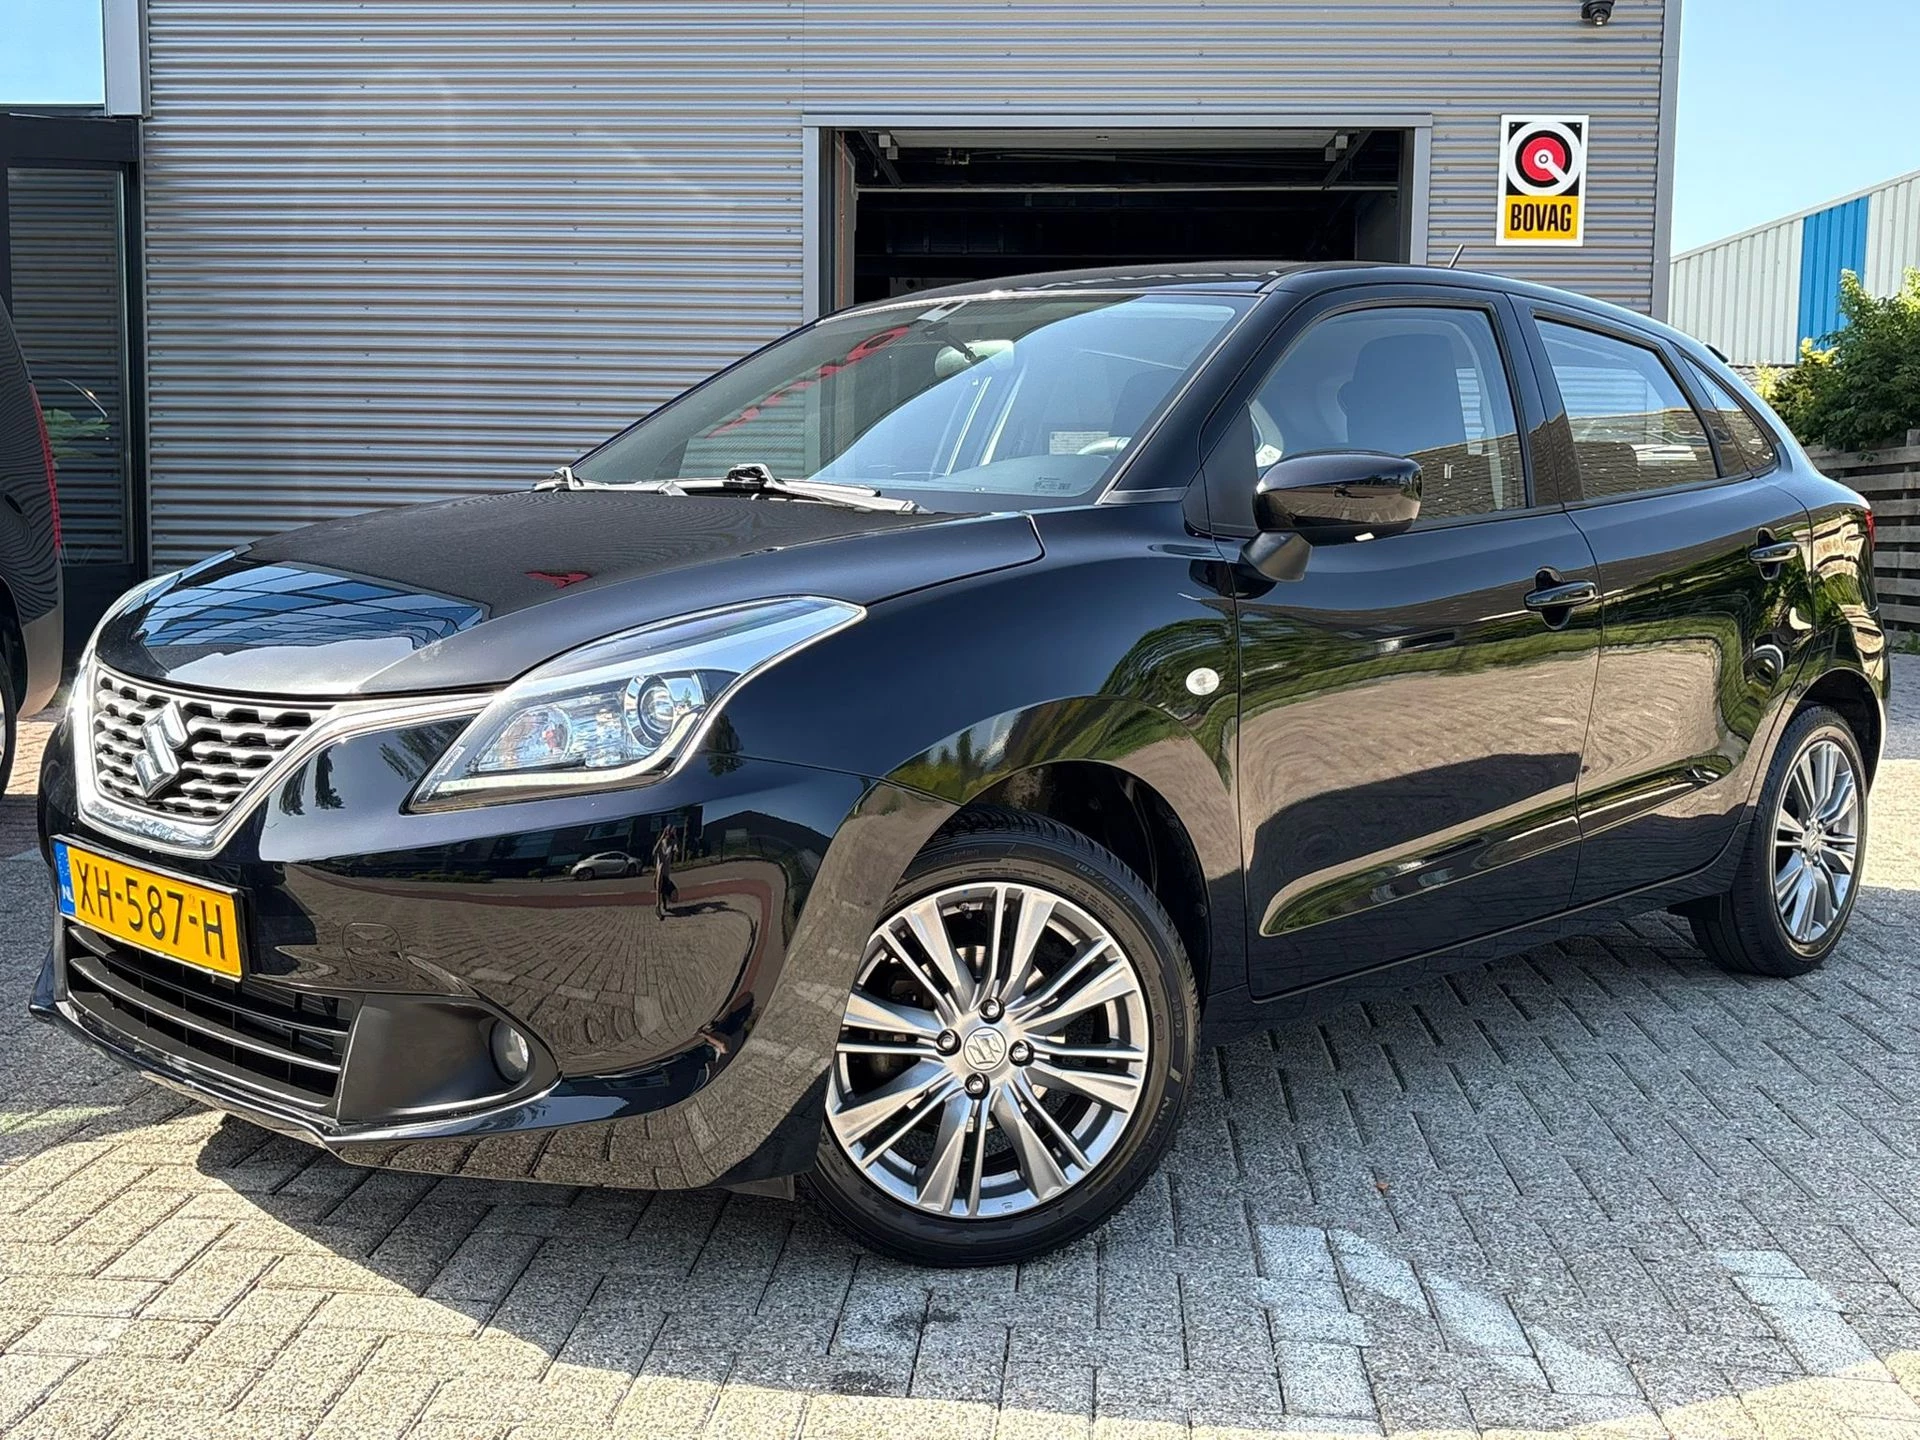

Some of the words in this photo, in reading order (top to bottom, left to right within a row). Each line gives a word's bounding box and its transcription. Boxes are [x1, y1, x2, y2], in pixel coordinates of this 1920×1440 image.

[1510, 203, 1572, 232] BOVAG
[61, 885, 75, 904] NL
[75, 859, 226, 960] XH-587-H
